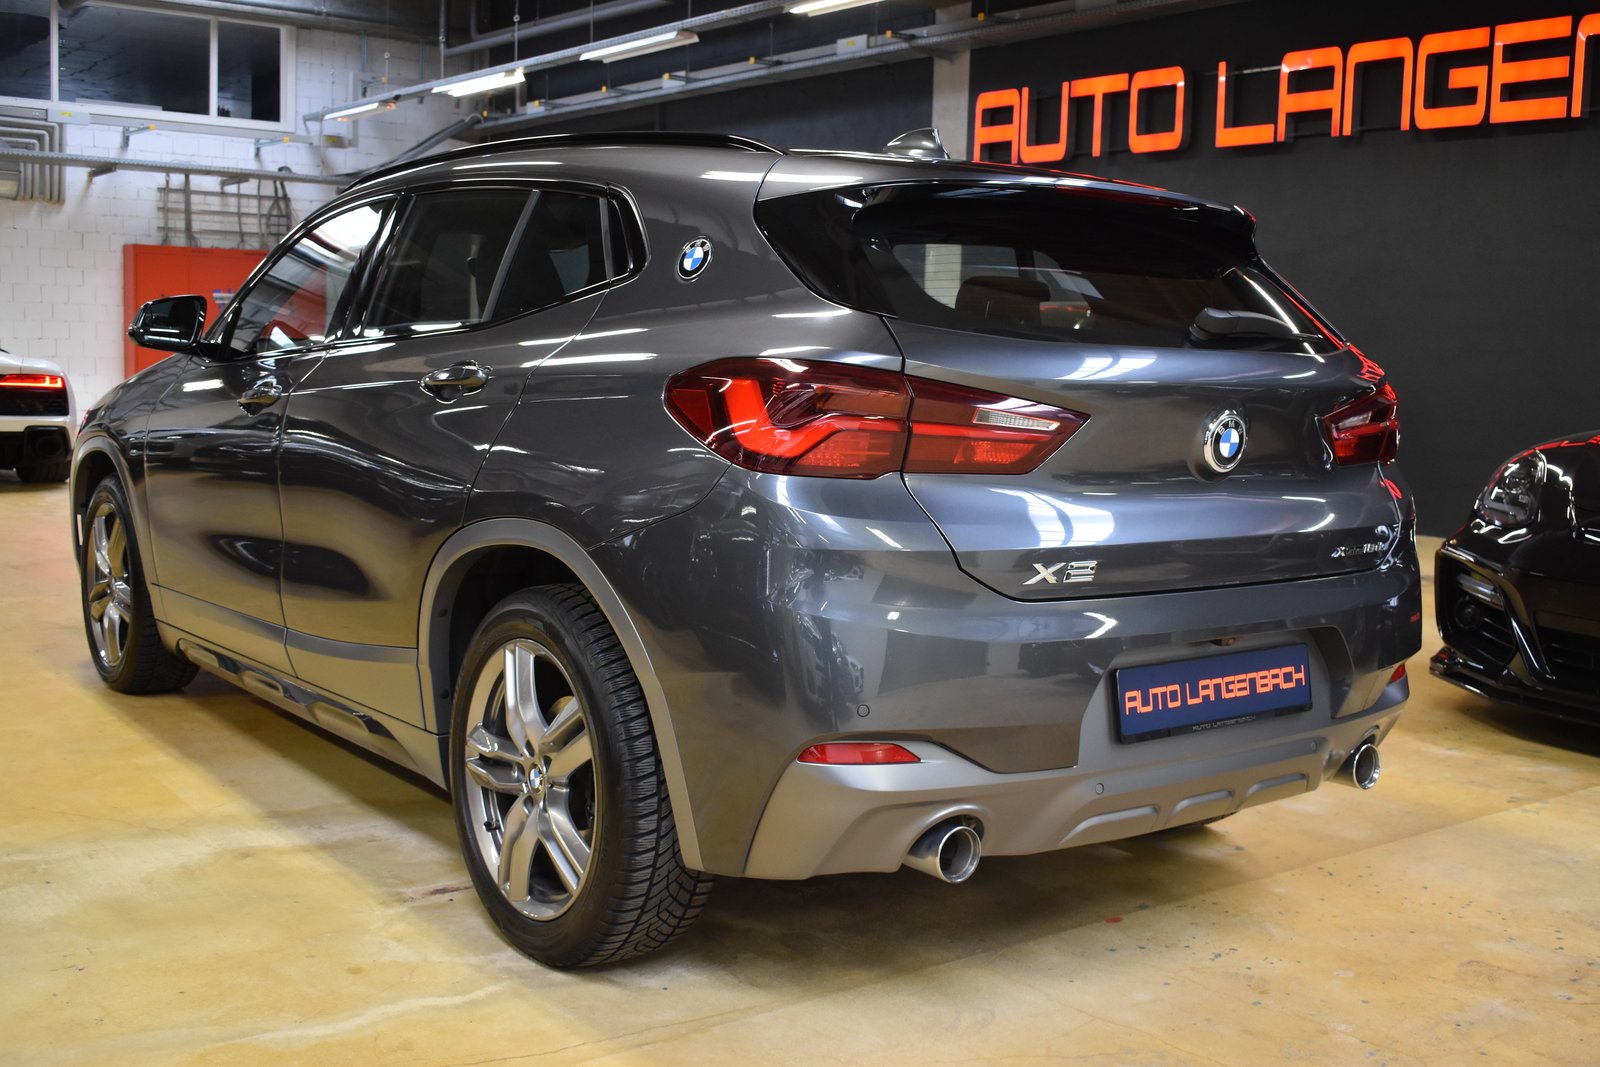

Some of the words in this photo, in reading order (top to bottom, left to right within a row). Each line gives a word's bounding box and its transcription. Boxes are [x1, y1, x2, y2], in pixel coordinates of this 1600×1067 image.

[973, 66, 1185, 164] AUTO
[1022, 560, 1098, 585] X2
[1124, 684, 1181, 715] AUTO
[1186, 664, 1306, 705] LANGENBACH
